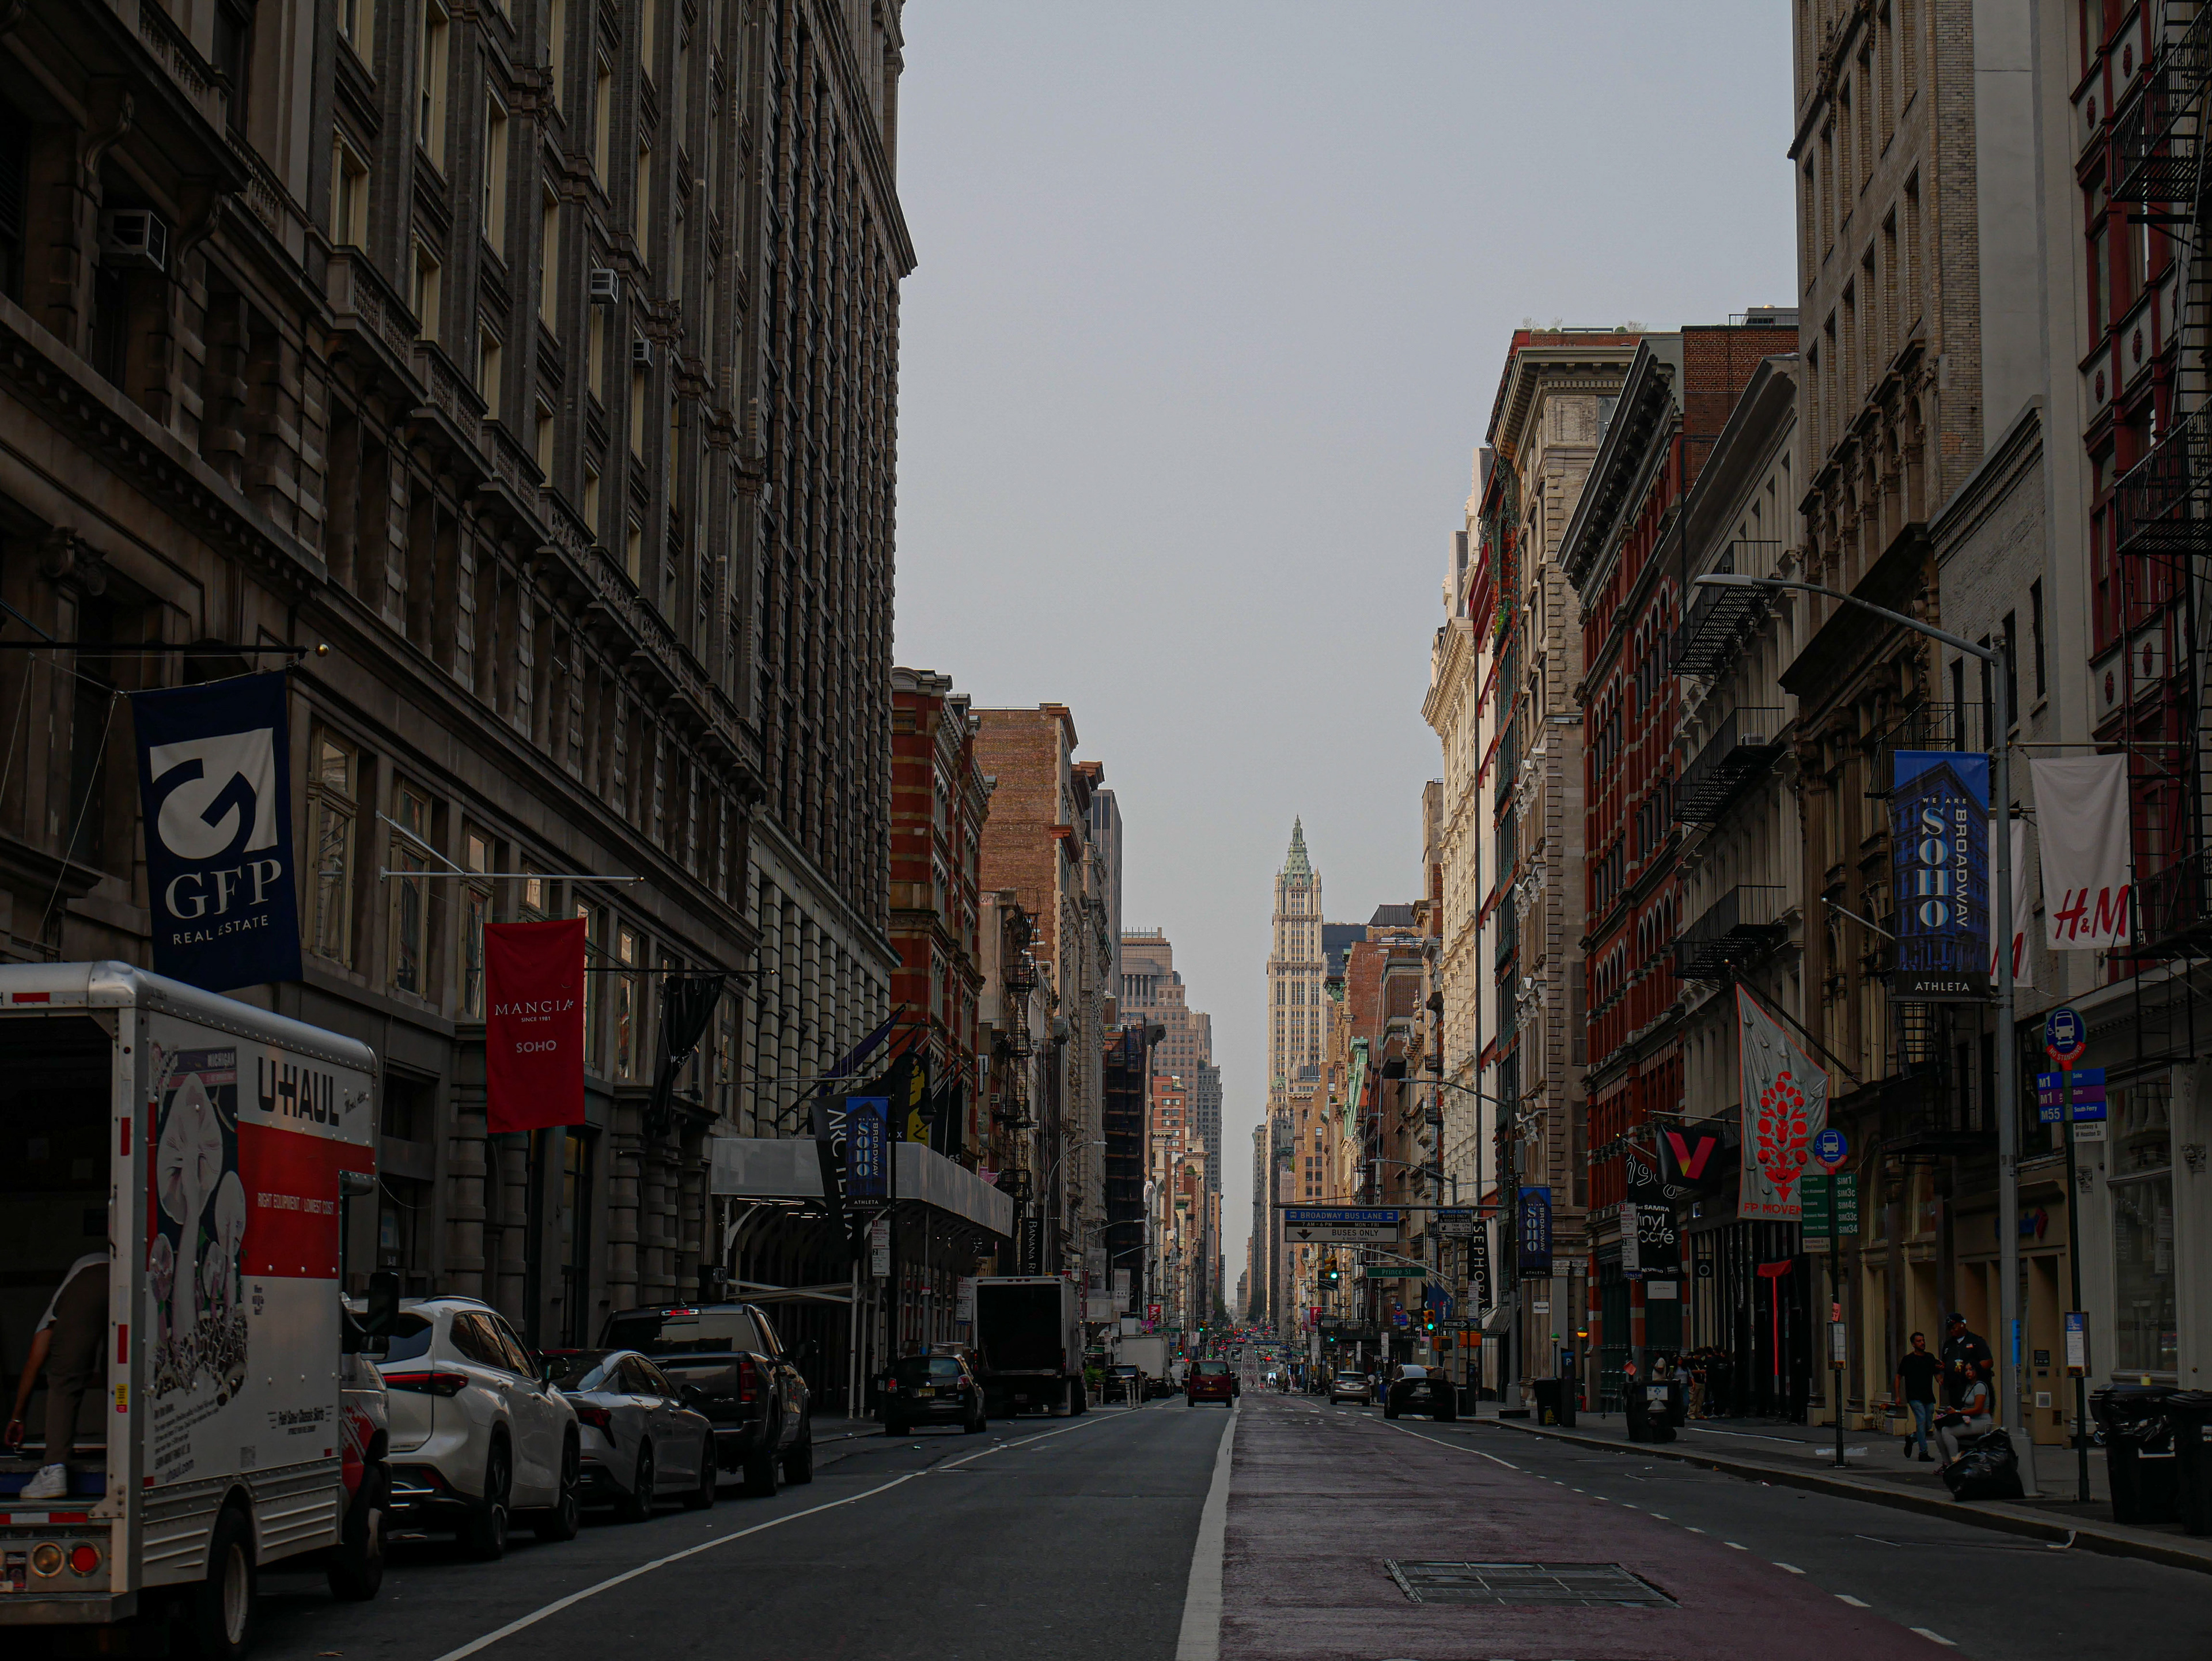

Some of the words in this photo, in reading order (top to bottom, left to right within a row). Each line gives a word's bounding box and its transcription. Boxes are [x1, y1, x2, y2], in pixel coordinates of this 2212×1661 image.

[1917, 808, 1950, 928] SOHO
[1956, 809, 1968, 928] BROADWAY
[165, 858, 282, 920] GFP
[2053, 884, 2130, 941] H&M
[173, 928, 213, 945] REAL
[218, 915, 269, 936] ESTATE
[1915, 981, 1970, 992] ATHLETA
[495, 999, 573, 1016] MANGIA
[516, 1040, 557, 1053] SOHO
[2049, 1047, 2057, 1057] NO
[2057, 1045, 2082, 1061] STANDING
[2039, 1075, 2051, 1088] M1
[2040, 1092, 2052, 1104] M1
[2041, 1108, 2061, 1120] M55
[1837, 1176, 1851, 1185] SIM1
[1838, 1188, 1855, 1197] SIM3c
[1744, 1202, 1759, 1213] FP
[1838, 1200, 1856, 1209] SIM4c
[1839, 1224, 1858, 1234] SIM34
[1029, 1221, 1037, 1259] BANANA
[1638, 1228, 1674, 1248] Café
[1473, 1225, 1486, 1304] SEPHORA
[1566, 1358, 1572, 1366] P
